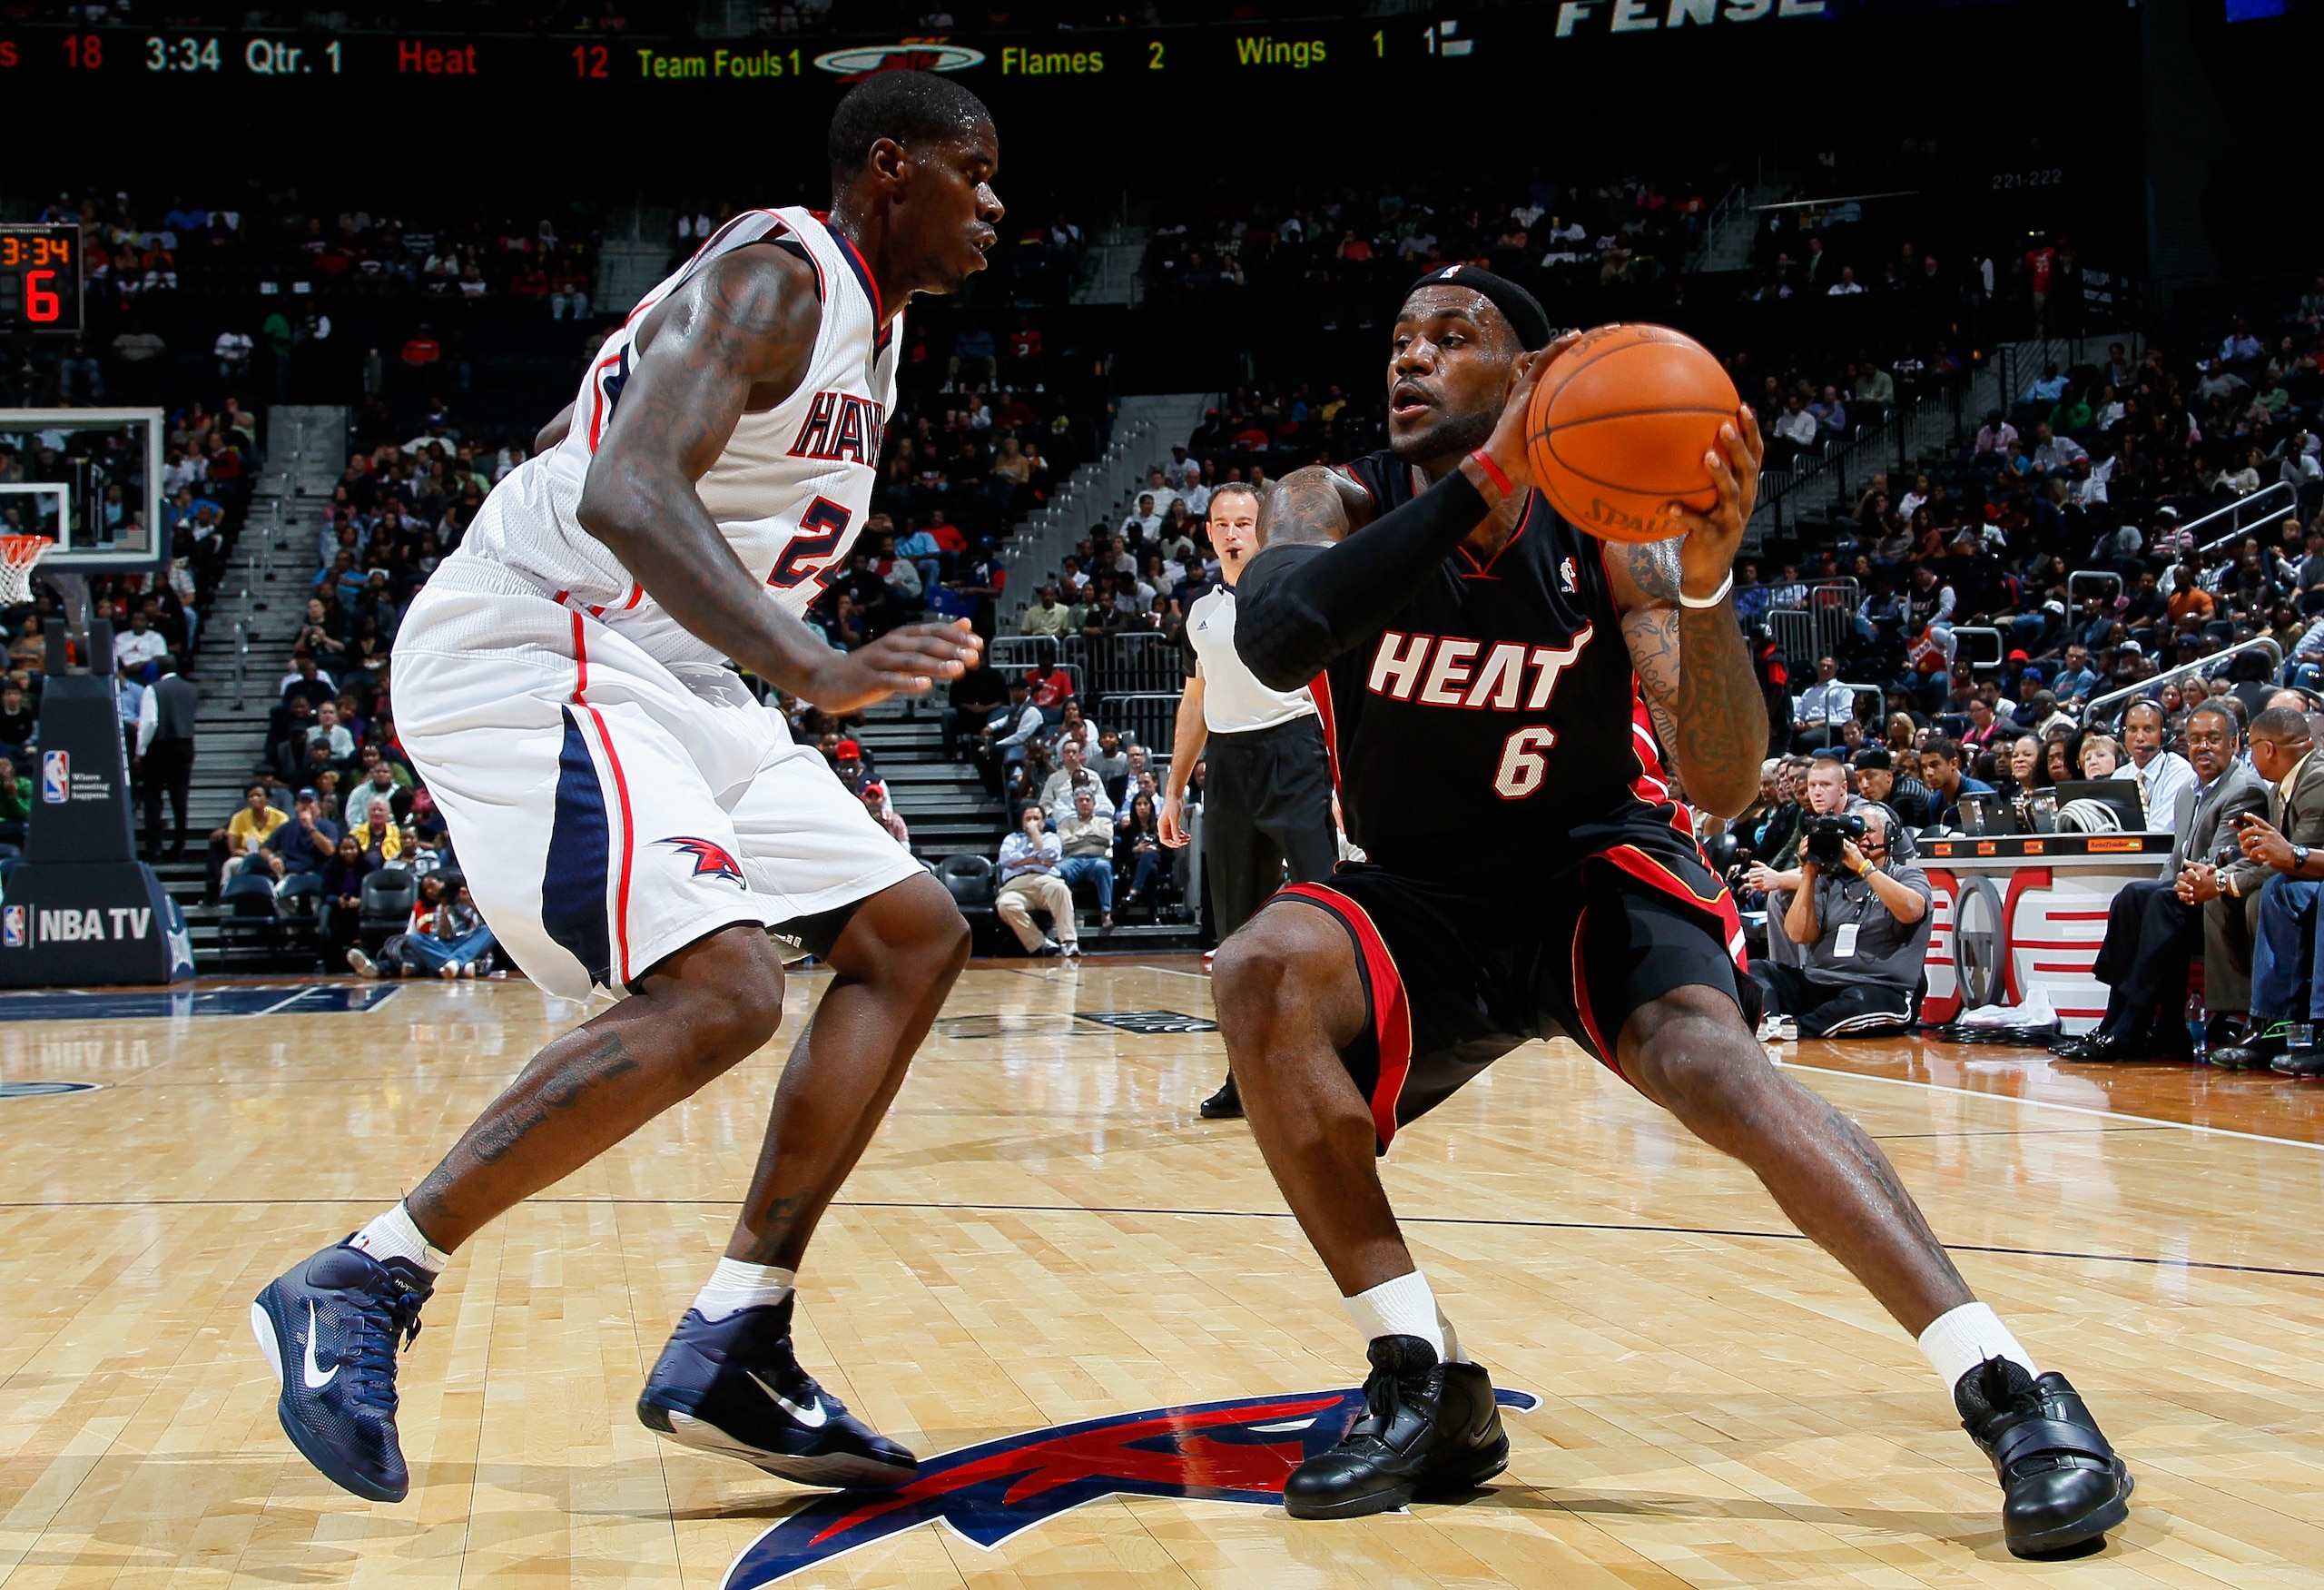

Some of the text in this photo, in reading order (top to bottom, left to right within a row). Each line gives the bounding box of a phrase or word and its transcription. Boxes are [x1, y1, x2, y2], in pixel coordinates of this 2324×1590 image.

[64, 35, 103, 69] 18
[145, 36, 221, 72] 3:34
[245, 38, 341, 74] Qtr. 1
[399, 41, 609, 77] Heat 12
[637, 49, 801, 78] Team Fouls 1
[1001, 42, 1165, 74] Flames 2
[1236, 30, 1384, 68] Wings 1
[1992, 168, 2063, 191] 221-222
[2, 237, 70, 266] 3:34
[26, 270, 60, 321] 6
[1366, 618, 1594, 712] HEAT
[1492, 725, 1559, 801] 6
[39, 907, 153, 943] NBA TV
